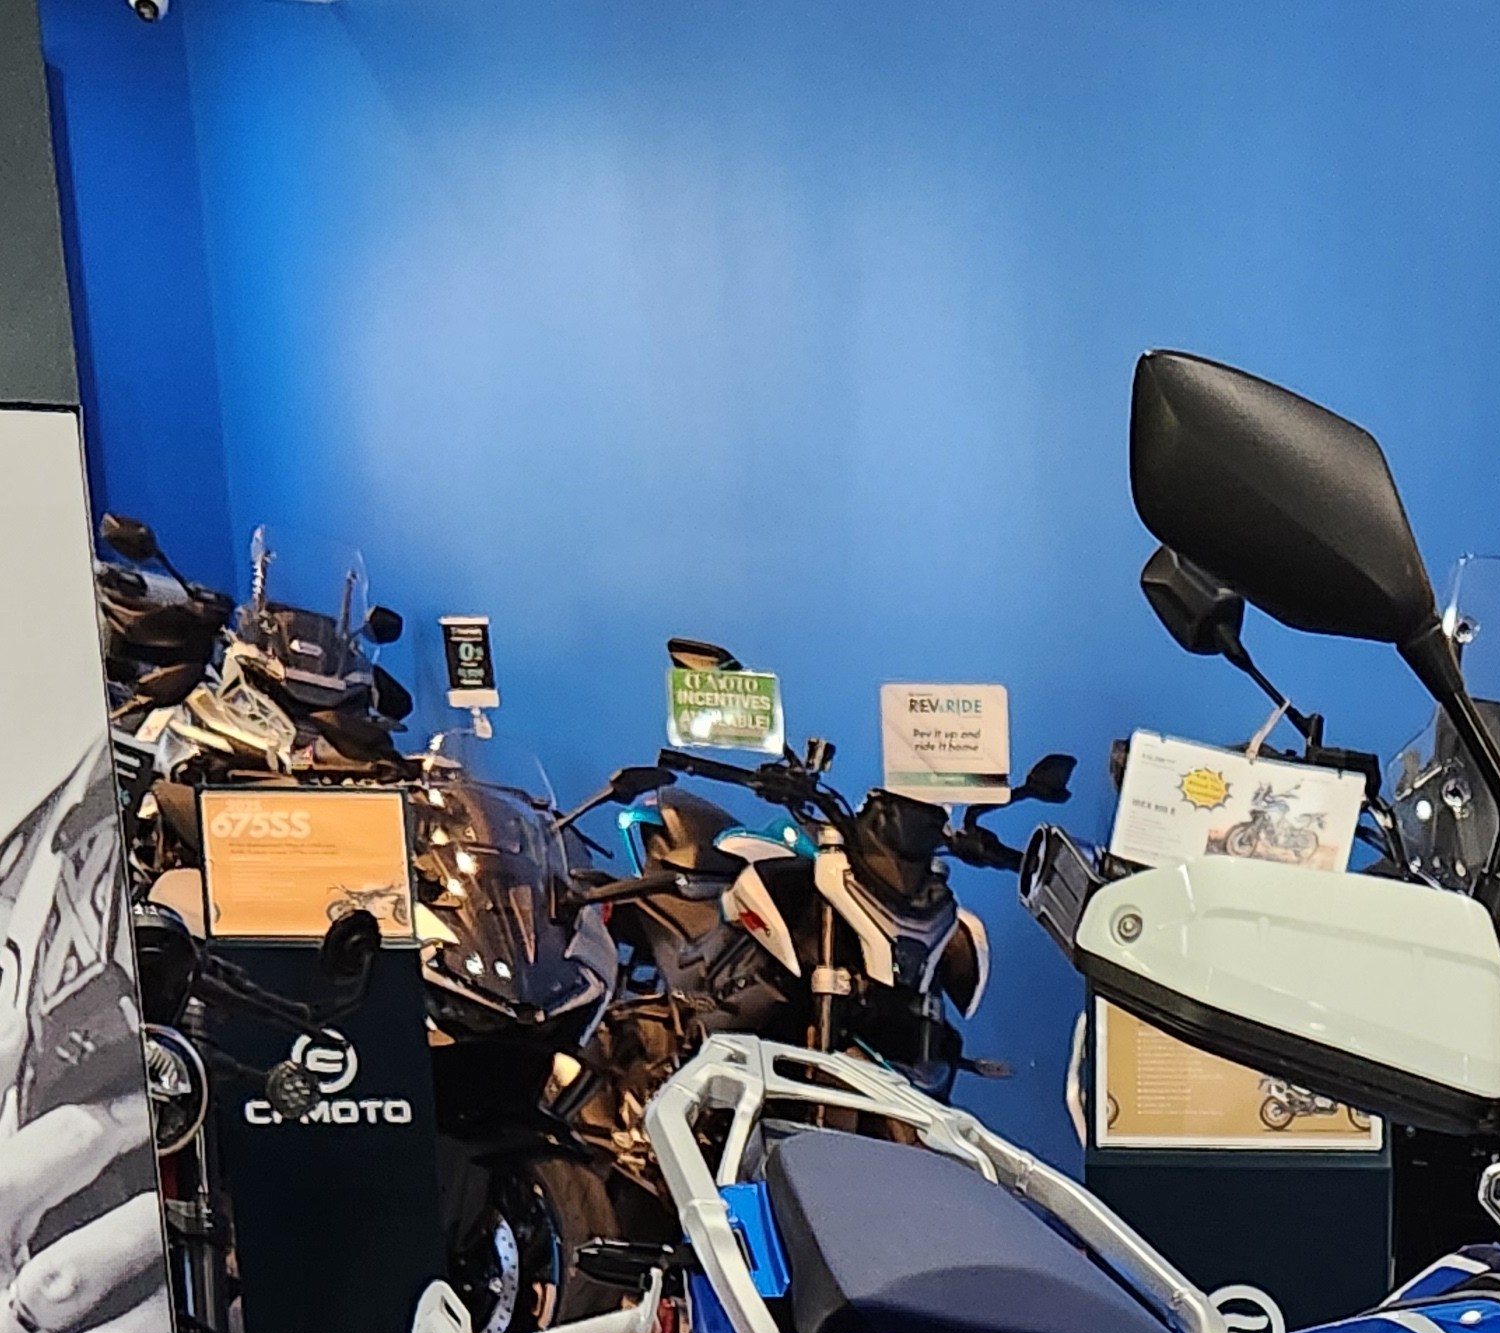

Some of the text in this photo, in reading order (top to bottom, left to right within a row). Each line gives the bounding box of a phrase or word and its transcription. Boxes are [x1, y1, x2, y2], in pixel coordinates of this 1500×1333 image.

[677, 689, 771, 711] INCENTIVES
[210, 809, 312, 839] 675SS
[244, 1098, 413, 1125] CMOTO
